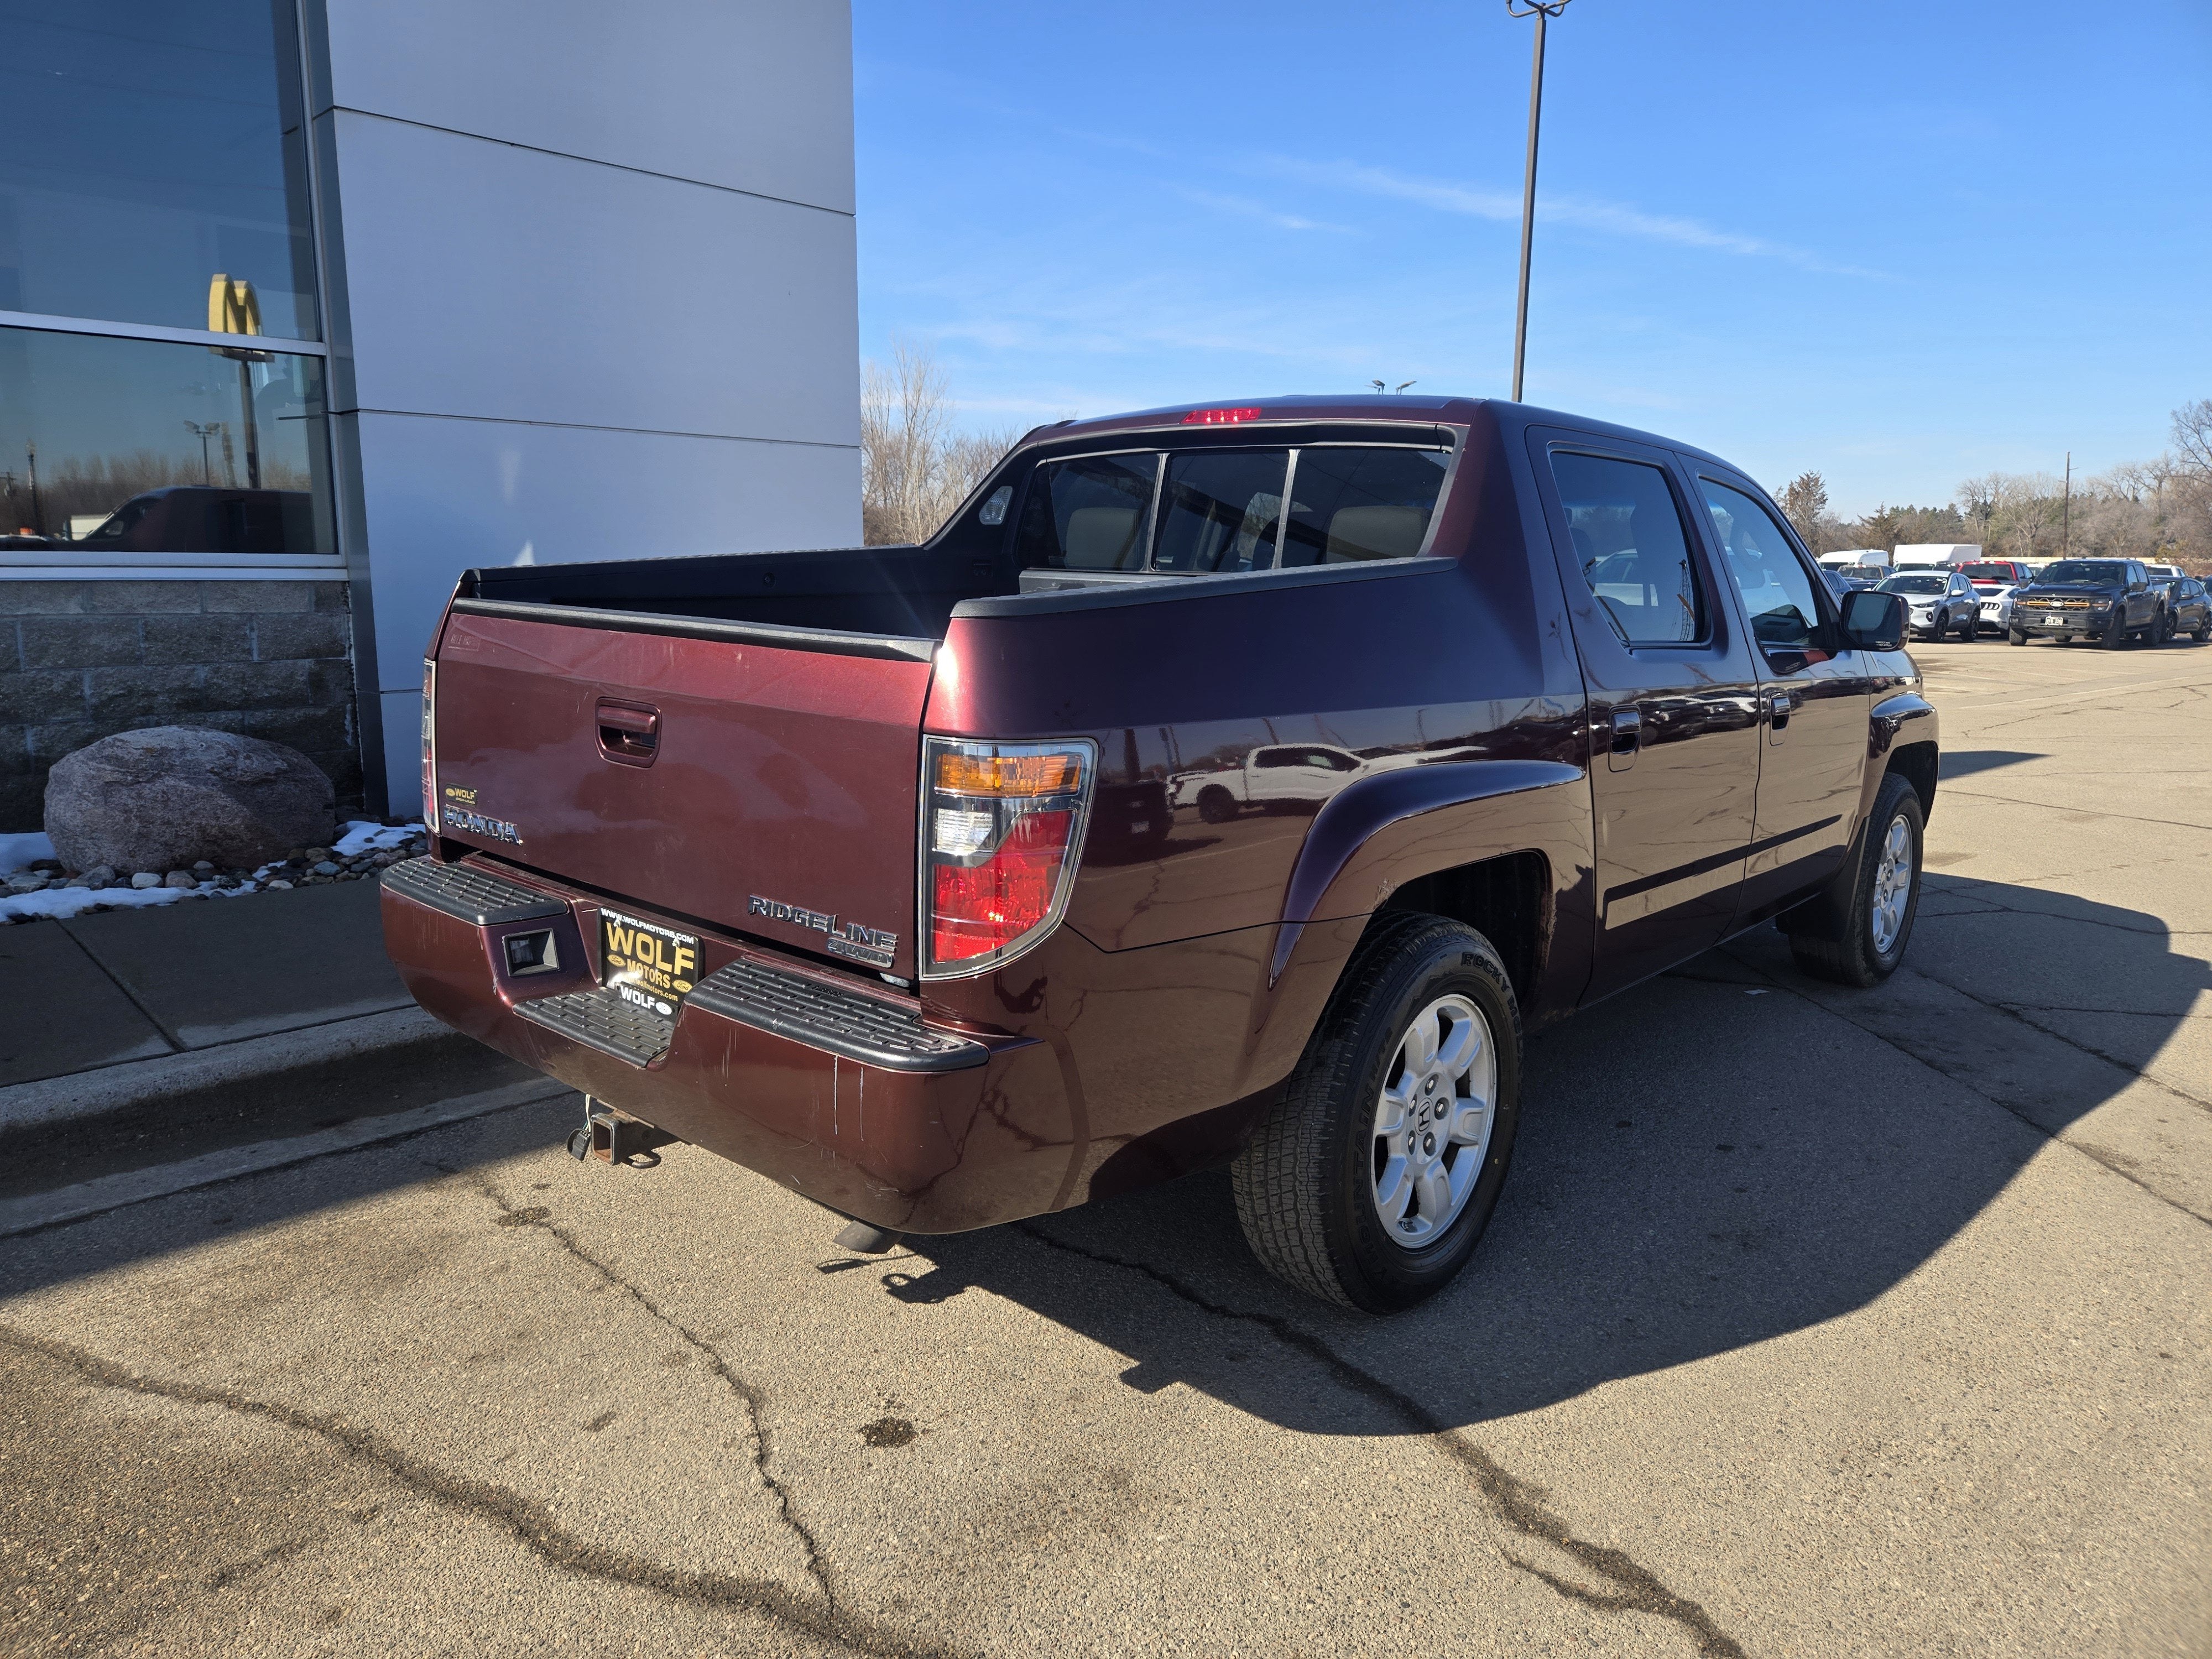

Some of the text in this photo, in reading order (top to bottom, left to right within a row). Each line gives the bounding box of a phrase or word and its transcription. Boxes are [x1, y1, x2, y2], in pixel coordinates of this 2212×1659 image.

[455, 787, 475, 800] WOLF
[444, 804, 524, 847] HONDA
[601, 907, 695, 945] WWW.WOLFMOTORS.COM
[748, 893, 899, 953] RIDGELINE
[606, 922, 695, 975] WOLF
[623, 976, 678, 1001] w.wolfmotors.com
[627, 958, 671, 989] MOTORS
[1461, 952, 1510, 993] ROCKY
[620, 985, 655, 1009] WOLF
[1352, 1084, 1380, 1265] MOUNTAIN
